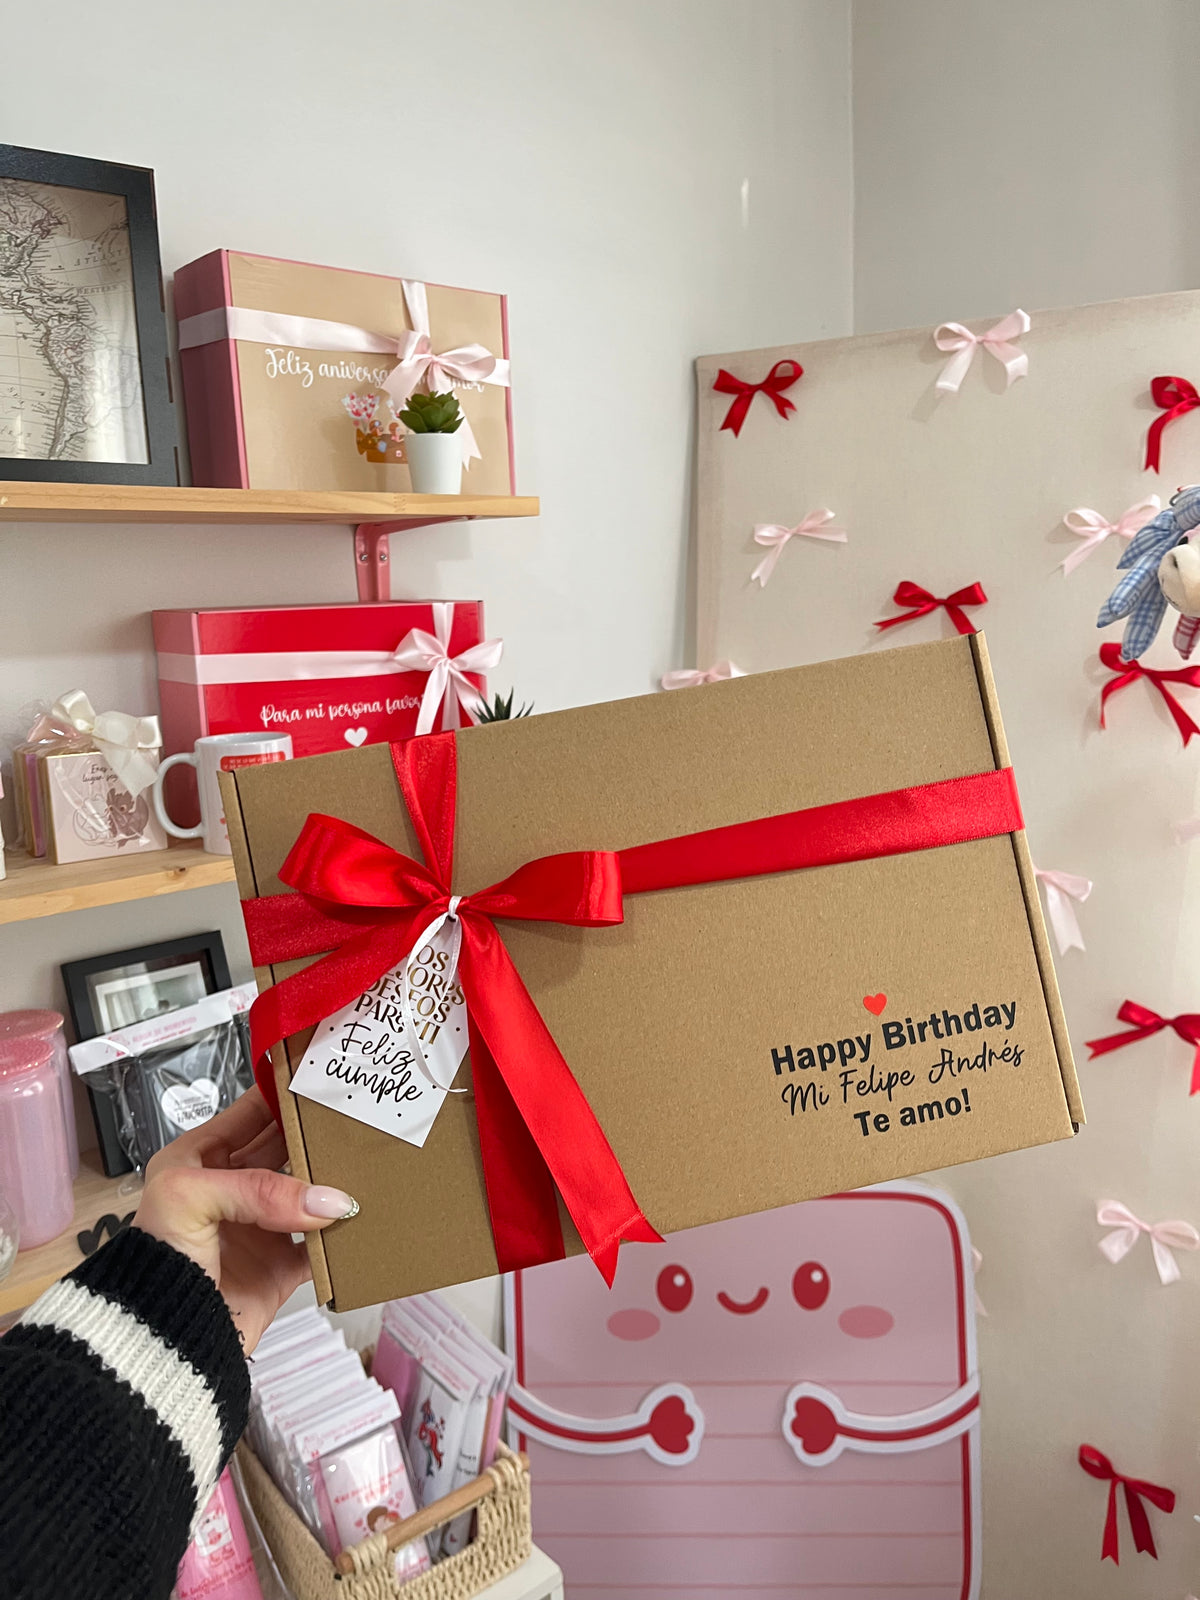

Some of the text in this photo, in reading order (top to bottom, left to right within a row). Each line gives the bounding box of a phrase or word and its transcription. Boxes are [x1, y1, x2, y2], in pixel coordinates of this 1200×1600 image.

[265, 348, 314, 388] Feliz
[260, 704, 302, 728] Para
[305, 703, 326, 719] mi
[328, 701, 383, 721] persona
[416, 944, 450, 972] OS
[340, 1020, 417, 1076] Feliz
[770, 1000, 1017, 1076] Happy Birthday
[325, 1058, 424, 1104] cumple
[781, 1038, 1026, 1117] Mi Felipe Andrés
[853, 1087, 972, 1137] Te amo!
